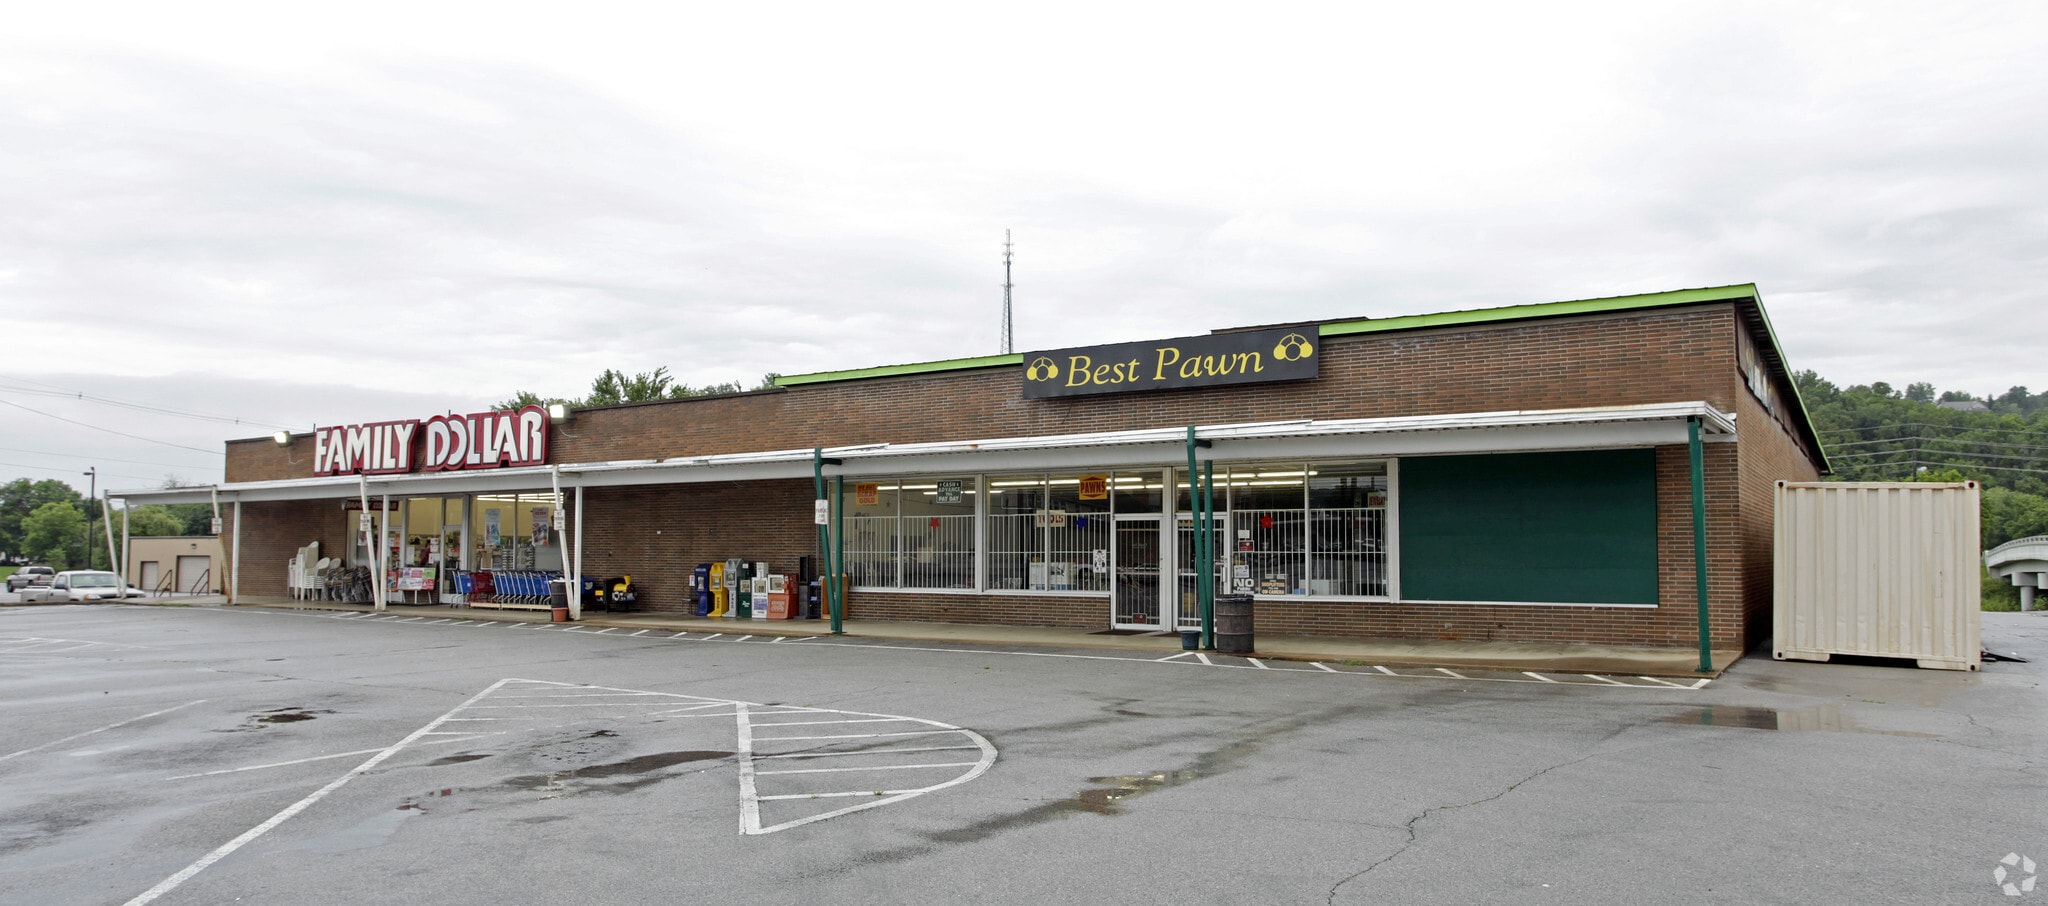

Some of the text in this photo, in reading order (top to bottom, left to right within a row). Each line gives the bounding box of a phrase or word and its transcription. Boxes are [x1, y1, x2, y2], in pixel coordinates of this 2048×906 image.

[1065, 347, 1264, 387] Best Pawn
[314, 411, 542, 473] FAMILY DOLLAR
[1081, 481, 1105, 494] PAWNS
[1233, 578, 1255, 587] NO
